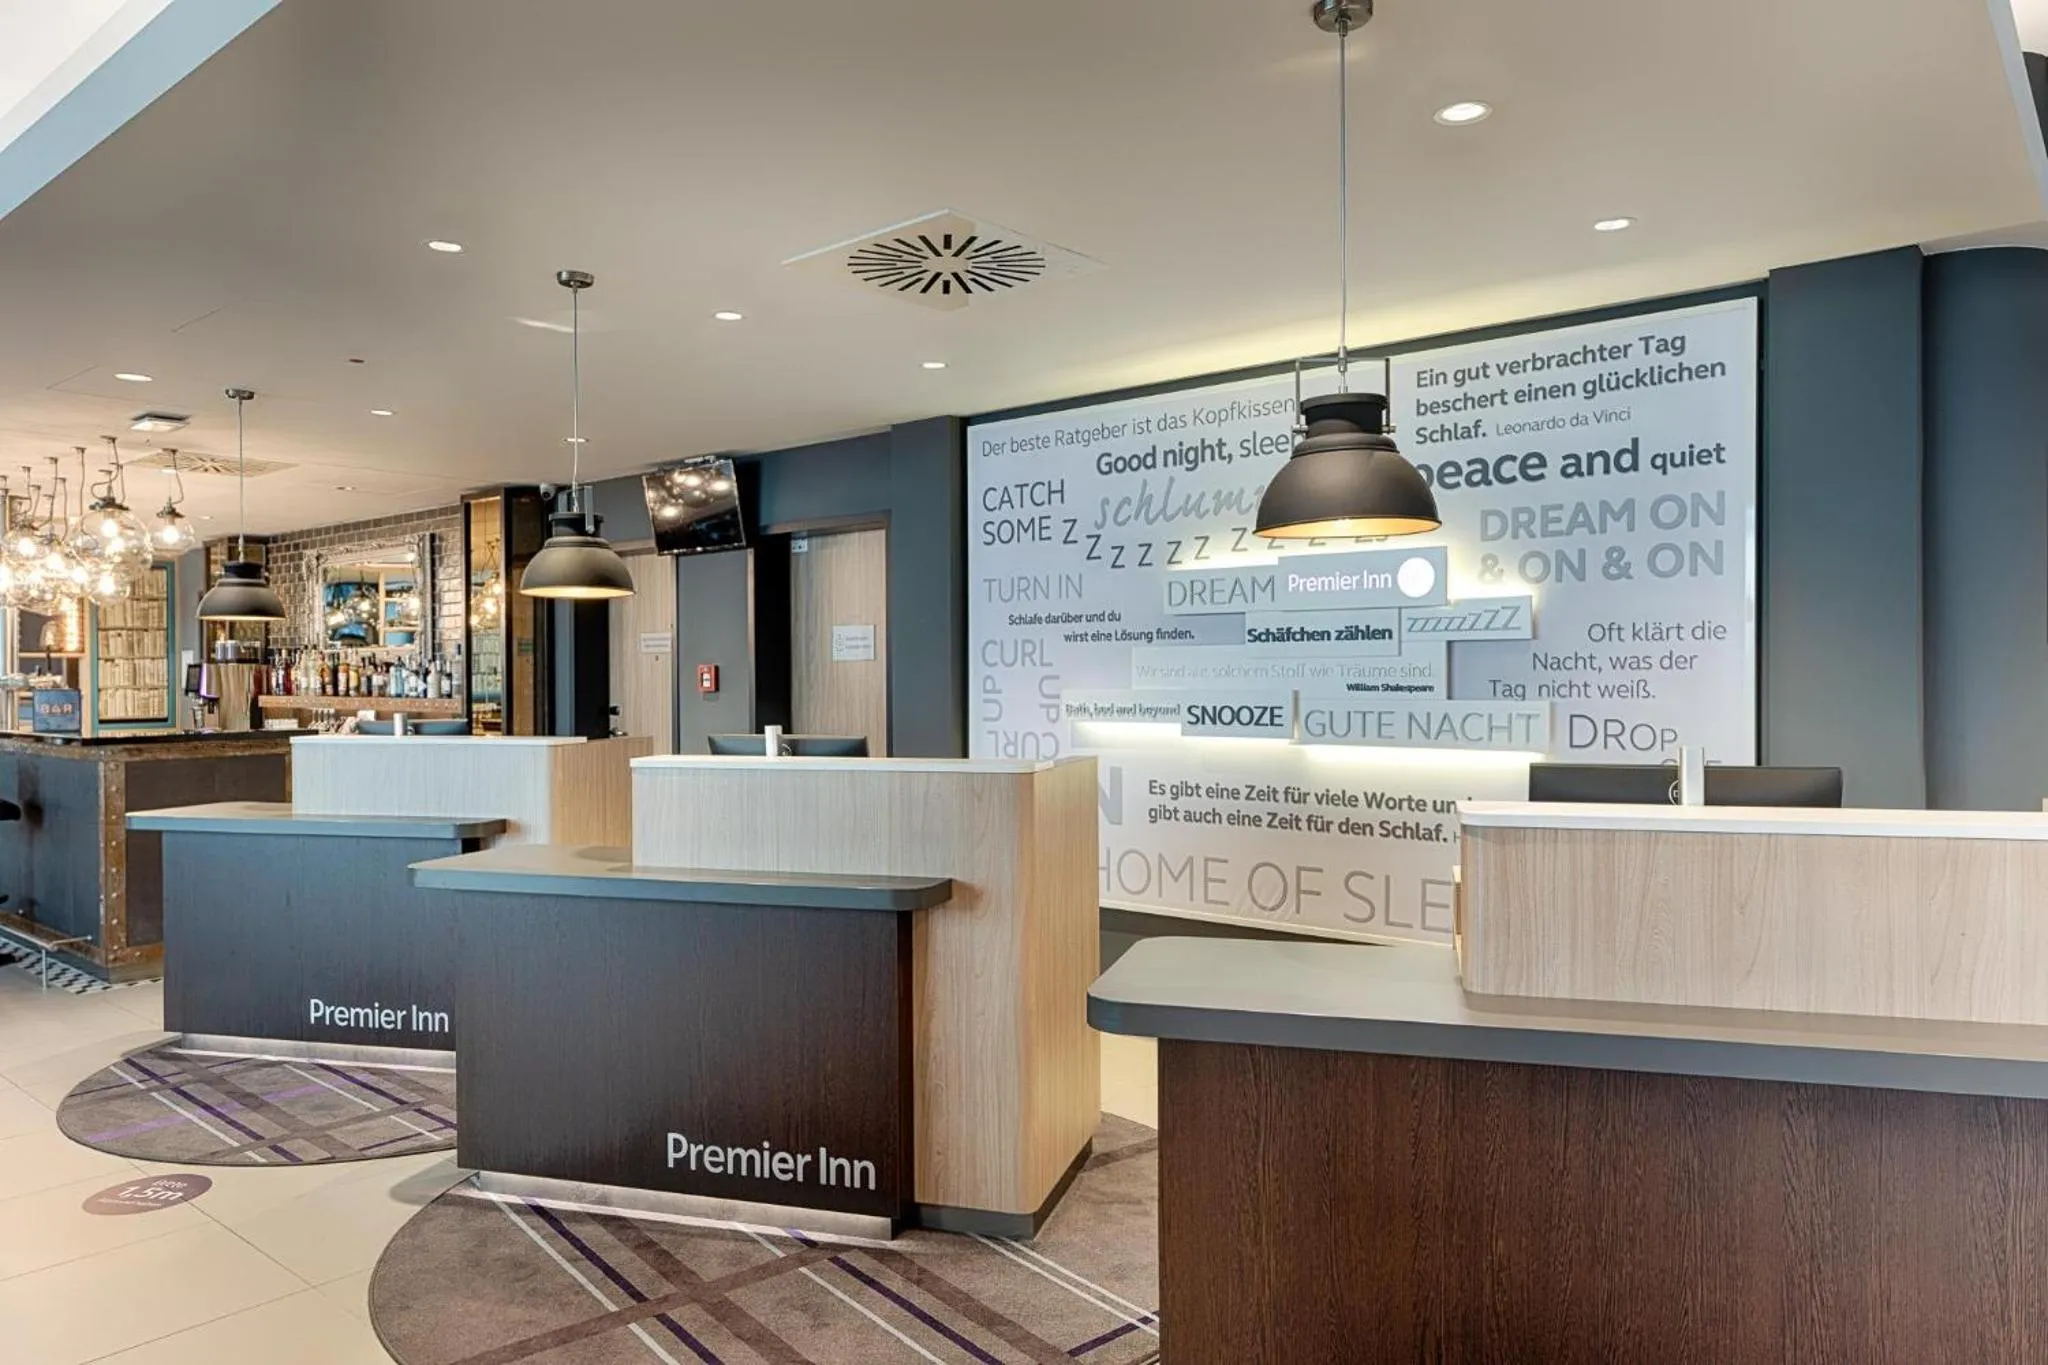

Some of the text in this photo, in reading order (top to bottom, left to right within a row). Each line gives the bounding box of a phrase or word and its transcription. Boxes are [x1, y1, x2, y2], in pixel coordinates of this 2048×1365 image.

[1416, 334, 1687, 388] Ein gut verbrachter Tag
[1415, 359, 1727, 417] beschert einen glücklichen
[982, 397, 1296, 457] Der beste Ratgeber ist das Kopfkissen
[1415, 406, 1632, 445] Schlaf. Leonardo da Vinci
[1096, 444, 1157, 476] Good
[1163, 437, 1234, 473] night,
[1559, 437, 1640, 479] and
[1649, 442, 1727, 476] quiet
[982, 478, 1065, 513] CATCH
[1094, 475, 1265, 530] schlum
[982, 516, 1052, 546] SOME
[1479, 490, 1726, 542] DREAM ON
[1480, 540, 1725, 585] & ON & ON
[983, 573, 1083, 603] TURN IN
[1168, 574, 1276, 607] DREAM
[1288, 569, 1392, 593] Premier Inn
[1008, 610, 1122, 626] Schlafe darüber und du
[1063, 627, 1196, 644] wirst eine Lösung finden.
[1247, 624, 1393, 643] Schäfchen zählen
[1587, 621, 1727, 642] Oft klärt die
[982, 637, 1054, 668] CURL
[1336, 662, 1398, 678] Träume
[1533, 650, 1699, 673] Nacht, was der
[982, 675, 1004, 722] UP
[1038, 675, 1060, 724] UP
[1346, 683, 1380, 692] William
[1488, 678, 1656, 701] Tag nicht weiß.
[1116, 704, 1137, 716] and
[1186, 704, 1284, 728] SNOOZE
[1304, 709, 1541, 744] GUTE NACHT
[986, 731, 1059, 761] CURL
[1569, 714, 1678, 752] DROP
[1149, 780, 1471, 814] Es gibt eine Zeit für viele Worte un
[1148, 804, 1180, 824] gibt
[1183, 808, 1222, 825] auch
[1227, 810, 1263, 828] eine
[1266, 812, 1302, 831] Zeit
[1306, 814, 1334, 834] für
[1338, 817, 1374, 837] den
[1379, 821, 1448, 843] Schlaf.
[1247, 861, 1324, 915] OF
[309, 998, 449, 1033] Premier Inn
[666, 1132, 876, 1191] Premier Inn
